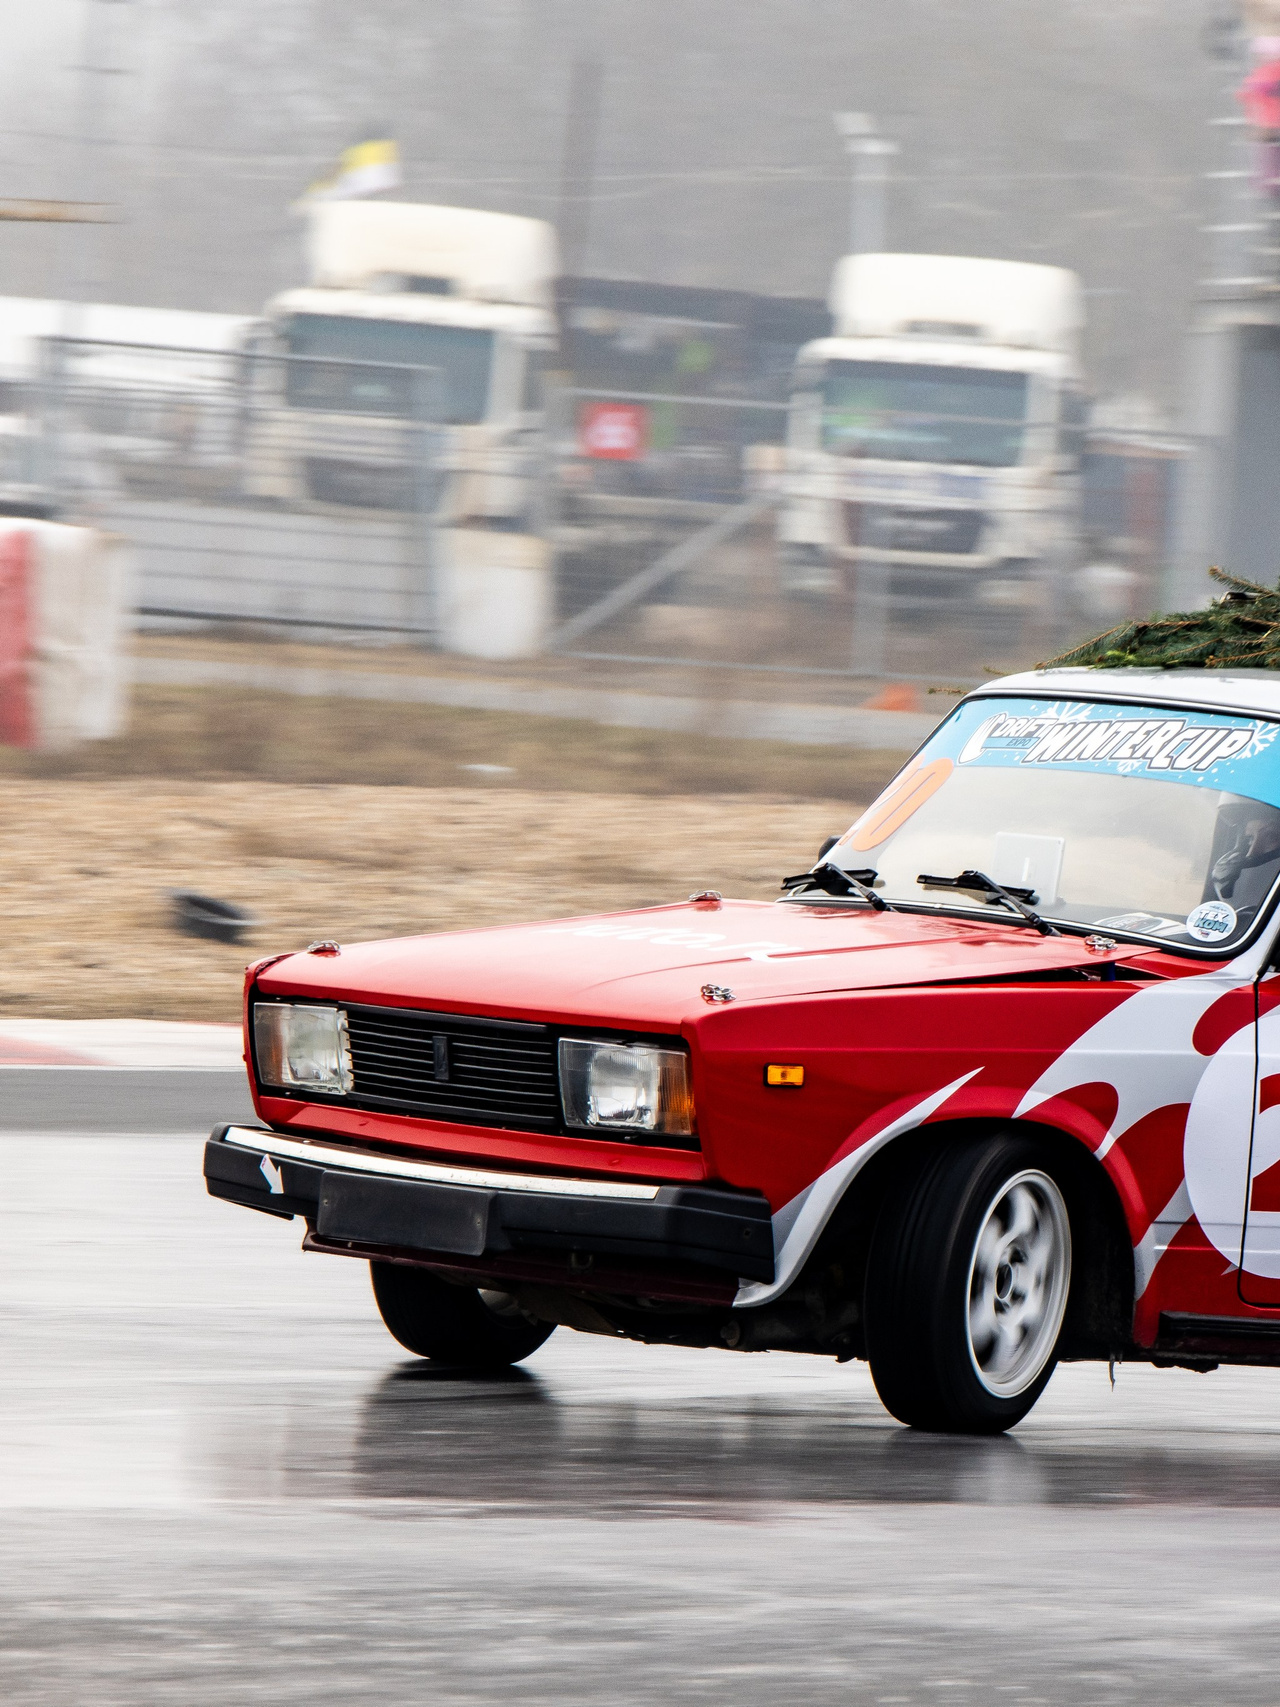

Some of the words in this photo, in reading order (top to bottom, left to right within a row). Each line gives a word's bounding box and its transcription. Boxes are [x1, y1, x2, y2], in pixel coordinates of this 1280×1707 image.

[994, 717, 1059, 738] DRIFT
[1005, 738, 1032, 747] EXPO
[528, 923, 832, 963] uto.ru
